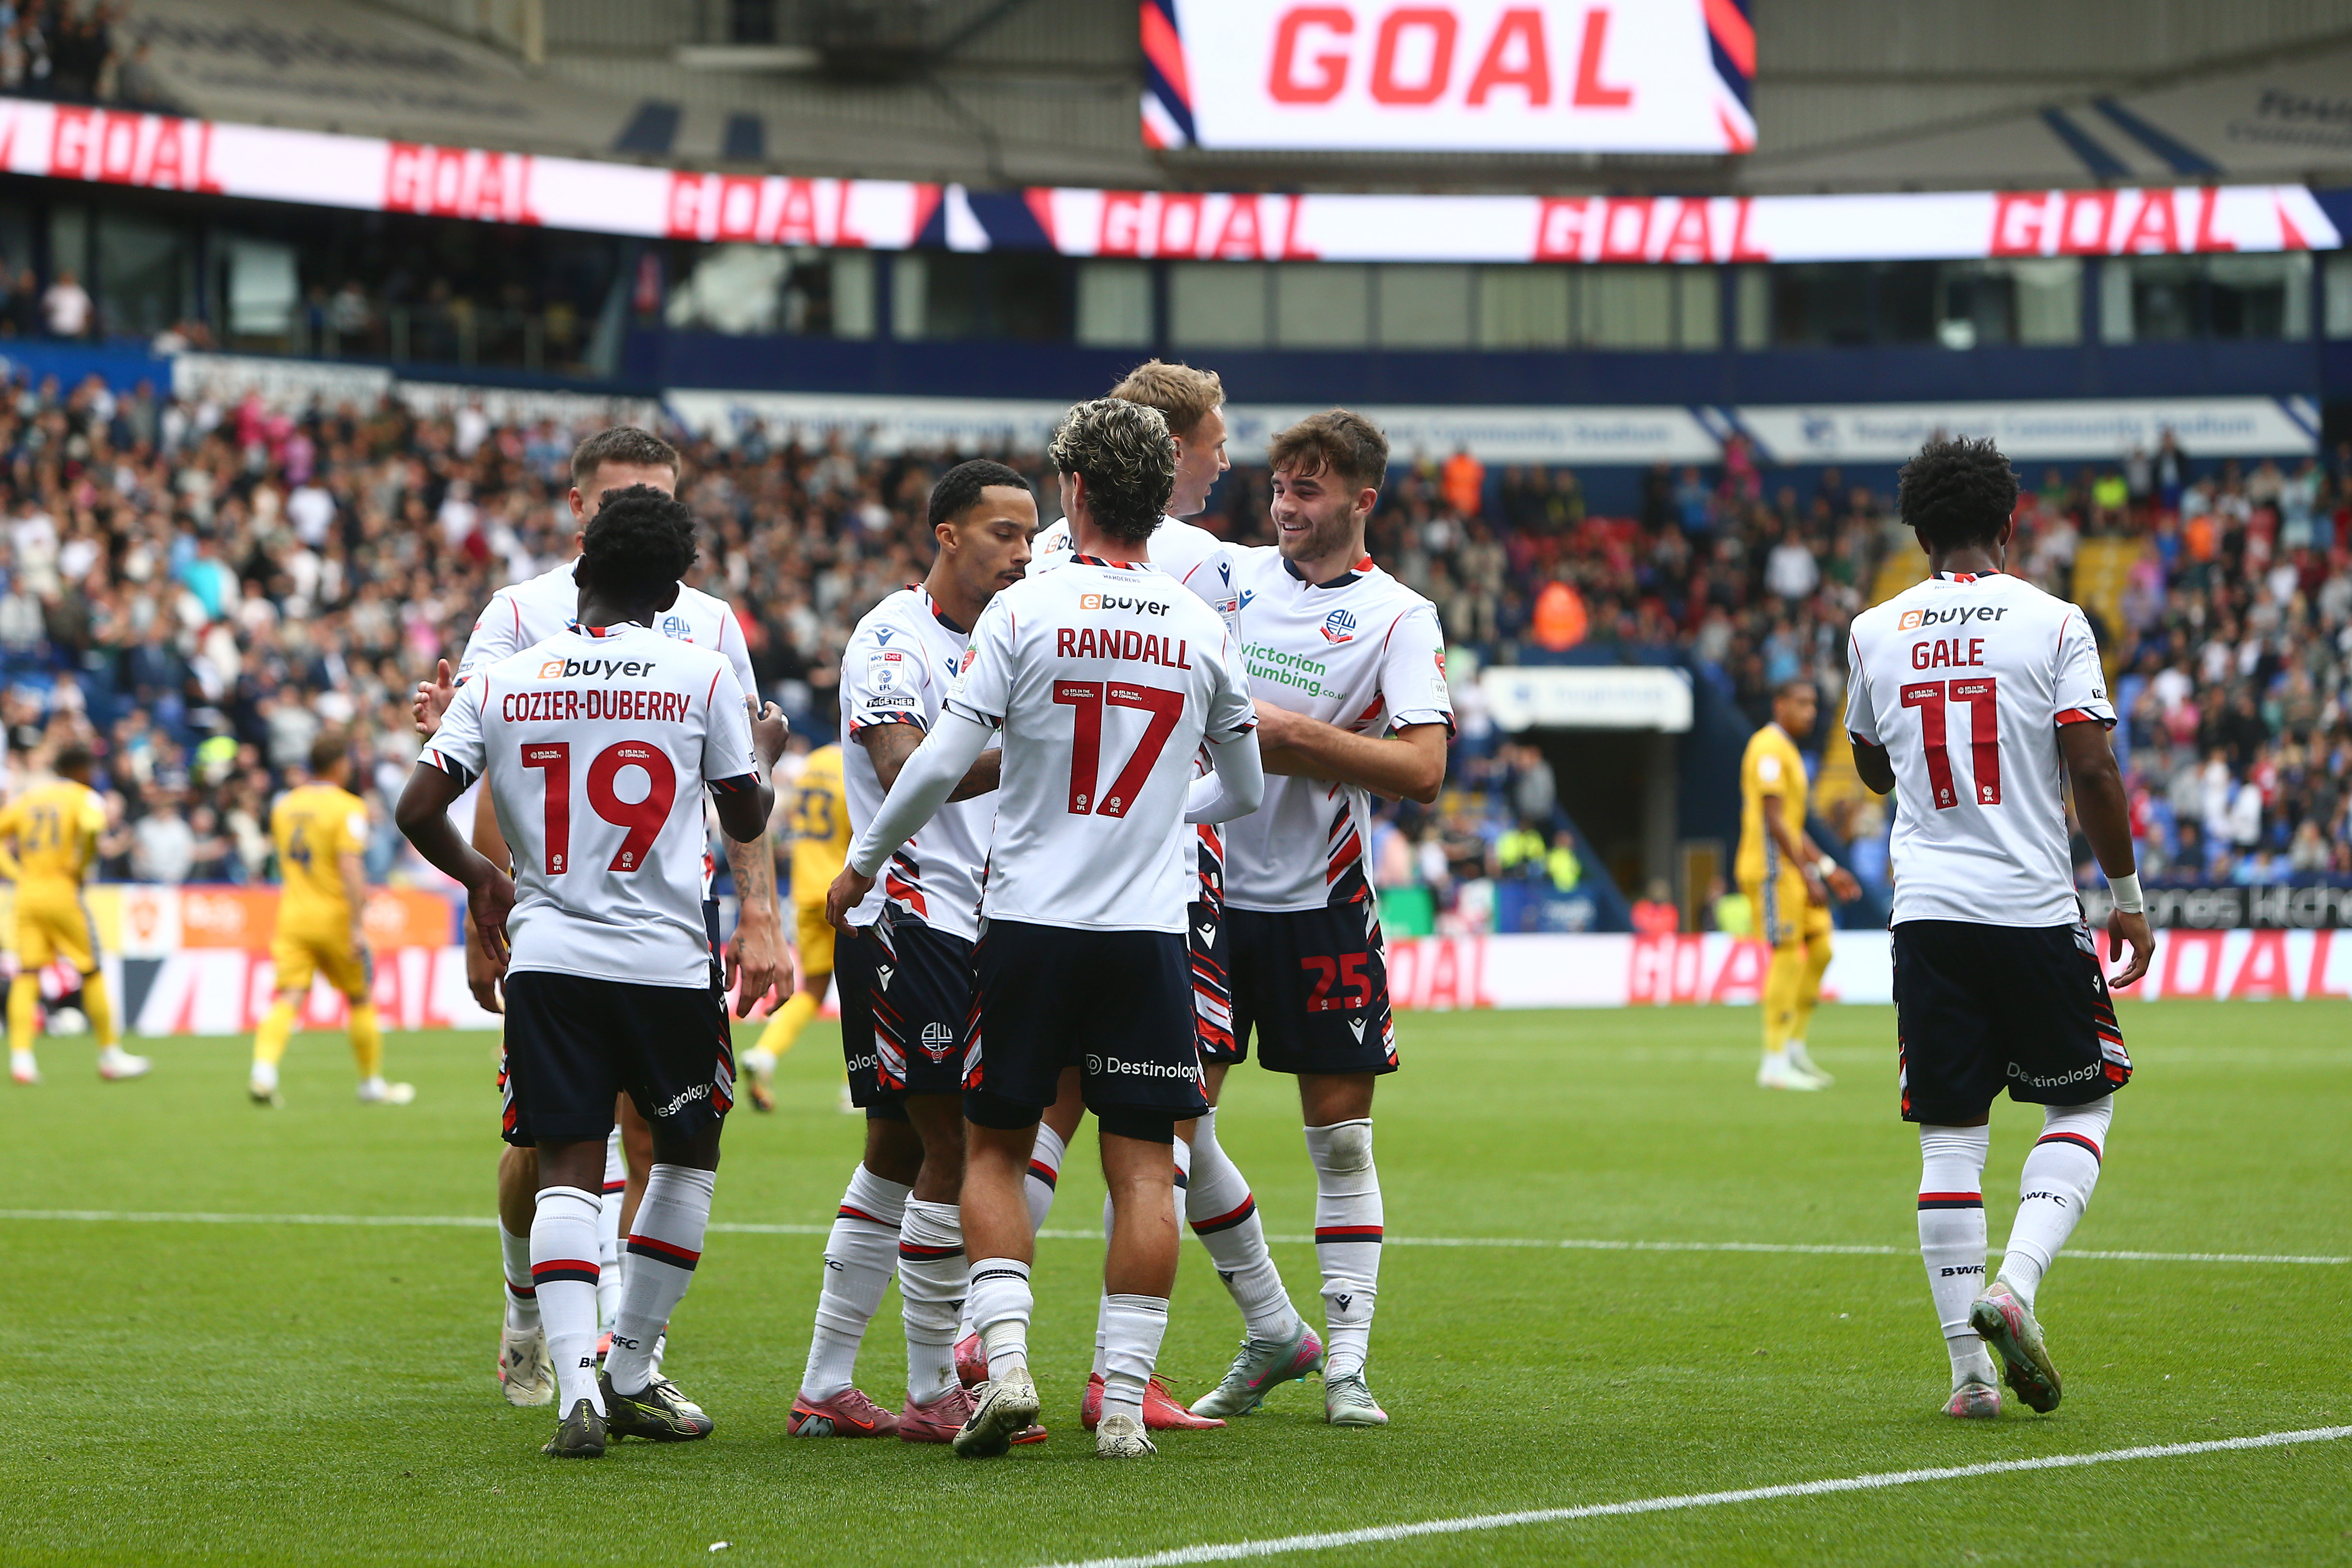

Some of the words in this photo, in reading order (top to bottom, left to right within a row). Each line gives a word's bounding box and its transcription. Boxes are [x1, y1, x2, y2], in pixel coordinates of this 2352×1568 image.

[1267, 4, 1633, 107] GOAL
[49, 104, 224, 195] GOAL
[384, 140, 541, 225] GOAL
[665, 171, 866, 248] GOAL
[1095, 190, 1321, 262] GOAL
[1532, 197, 1772, 263] GOAL
[1988, 187, 2237, 257] GOAL
[1103, 574, 1140, 583] WANDERERS
[1084, 594, 1169, 617] ebuyer
[1903, 607, 2008, 629] ebuyer
[543, 658, 656, 680] ebuyer
[1057, 628, 1192, 670] RANDALL
[1241, 641, 1327, 677] victorian
[1912, 638, 1985, 670] GALE
[1247, 659, 1347, 700] lumbing.co.u
[502, 690, 691, 723] COZIER-DUBERRY
[1053, 680, 1184, 819] 17
[1900, 677, 2001, 809] 11
[520, 740, 676, 875] 19
[1300, 952, 1372, 1012] 25
[1107, 1057, 1199, 1083] Destinology
[653, 1082, 713, 1118] estinology
